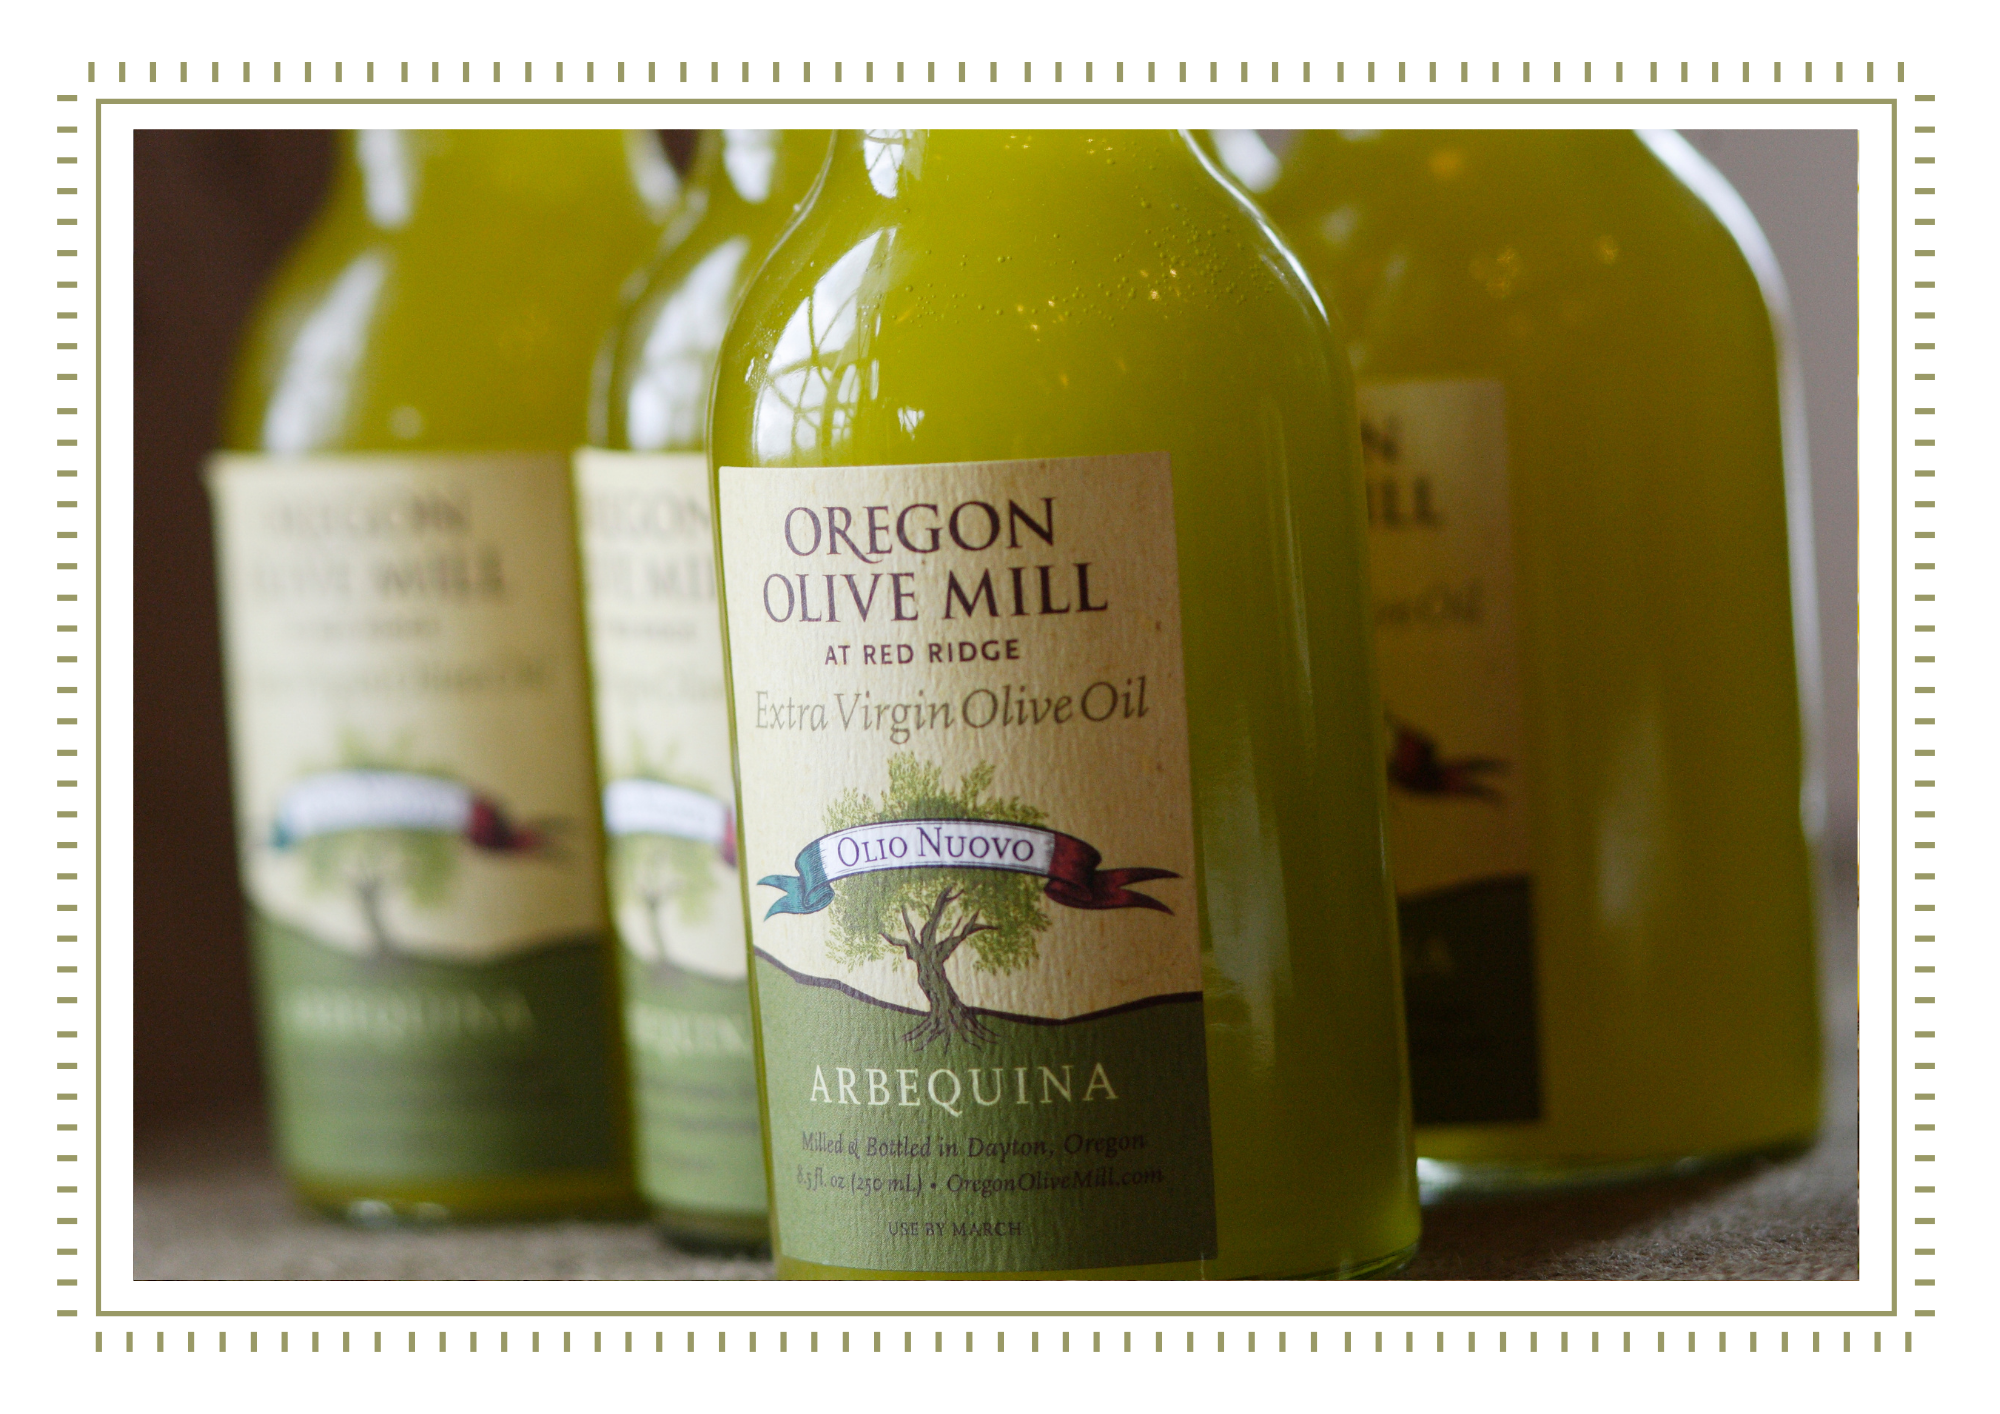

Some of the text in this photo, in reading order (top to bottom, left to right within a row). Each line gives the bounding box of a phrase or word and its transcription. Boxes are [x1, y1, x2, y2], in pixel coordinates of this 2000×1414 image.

[784, 497, 1057, 564] OREGON
[763, 572, 919, 623] OLIVE
[943, 562, 1109, 620] MILL
[825, 639, 1021, 665] AT RED RIDGE
[755, 675, 1150, 744] Extra Virgin Olive Oil
[837, 826, 1035, 868] OLIO NUOVO
[809, 1062, 1120, 1118] ARBEQUINA
[801, 1131, 844, 1154] Milled
[865, 1136, 932, 1158] Bottled
[938, 1137, 959, 1158] in
[967, 1137, 1055, 1164] Dayton,
[1063, 1133, 1146, 1159] Oregon
[830, 1177, 846, 1190] oz
[851, 1173, 883, 1197] (250
[888, 1174, 923, 1198] mL)
[947, 1166, 1164, 1198] OregonOliveMill.com
[888, 1221, 1023, 1237] USE BY MARCH
